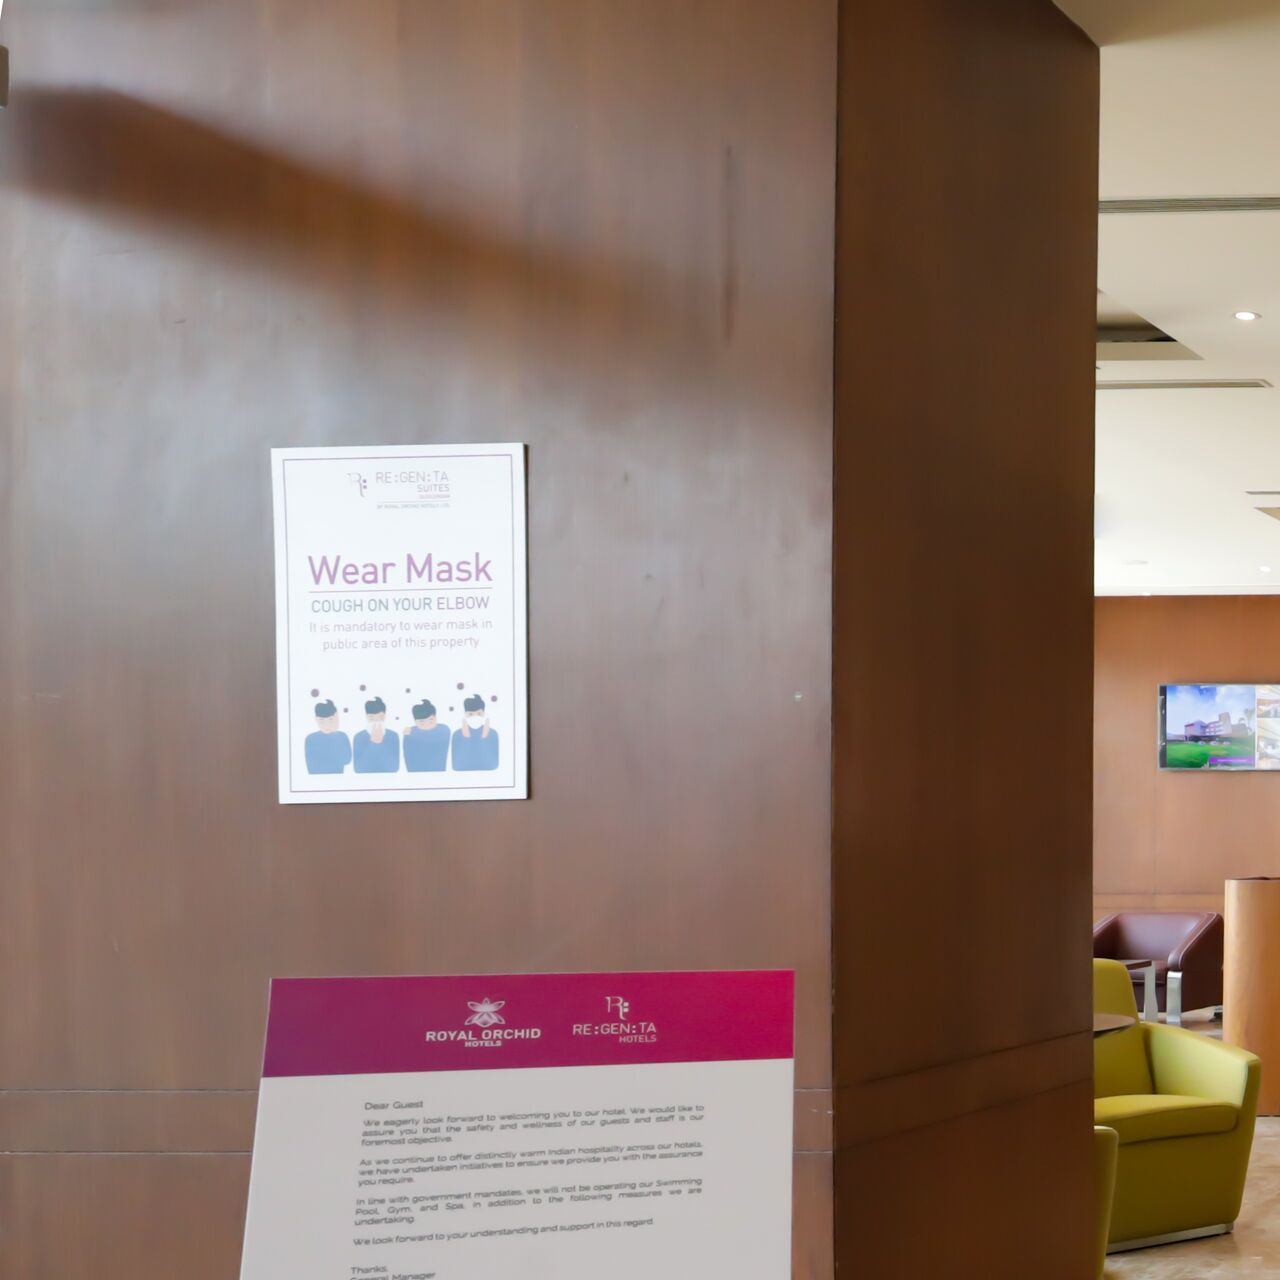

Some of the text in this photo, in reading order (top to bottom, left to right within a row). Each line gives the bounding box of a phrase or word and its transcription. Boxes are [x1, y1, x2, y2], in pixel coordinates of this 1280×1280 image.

[417, 483, 449, 492] SUITES
[309, 551, 492, 585] Wear Mask
[311, 595, 489, 613] COUGH ON YOUR ELBOW
[309, 617, 492, 634] It is mandatory to wear mask in
[323, 635, 479, 652] public area of this property
